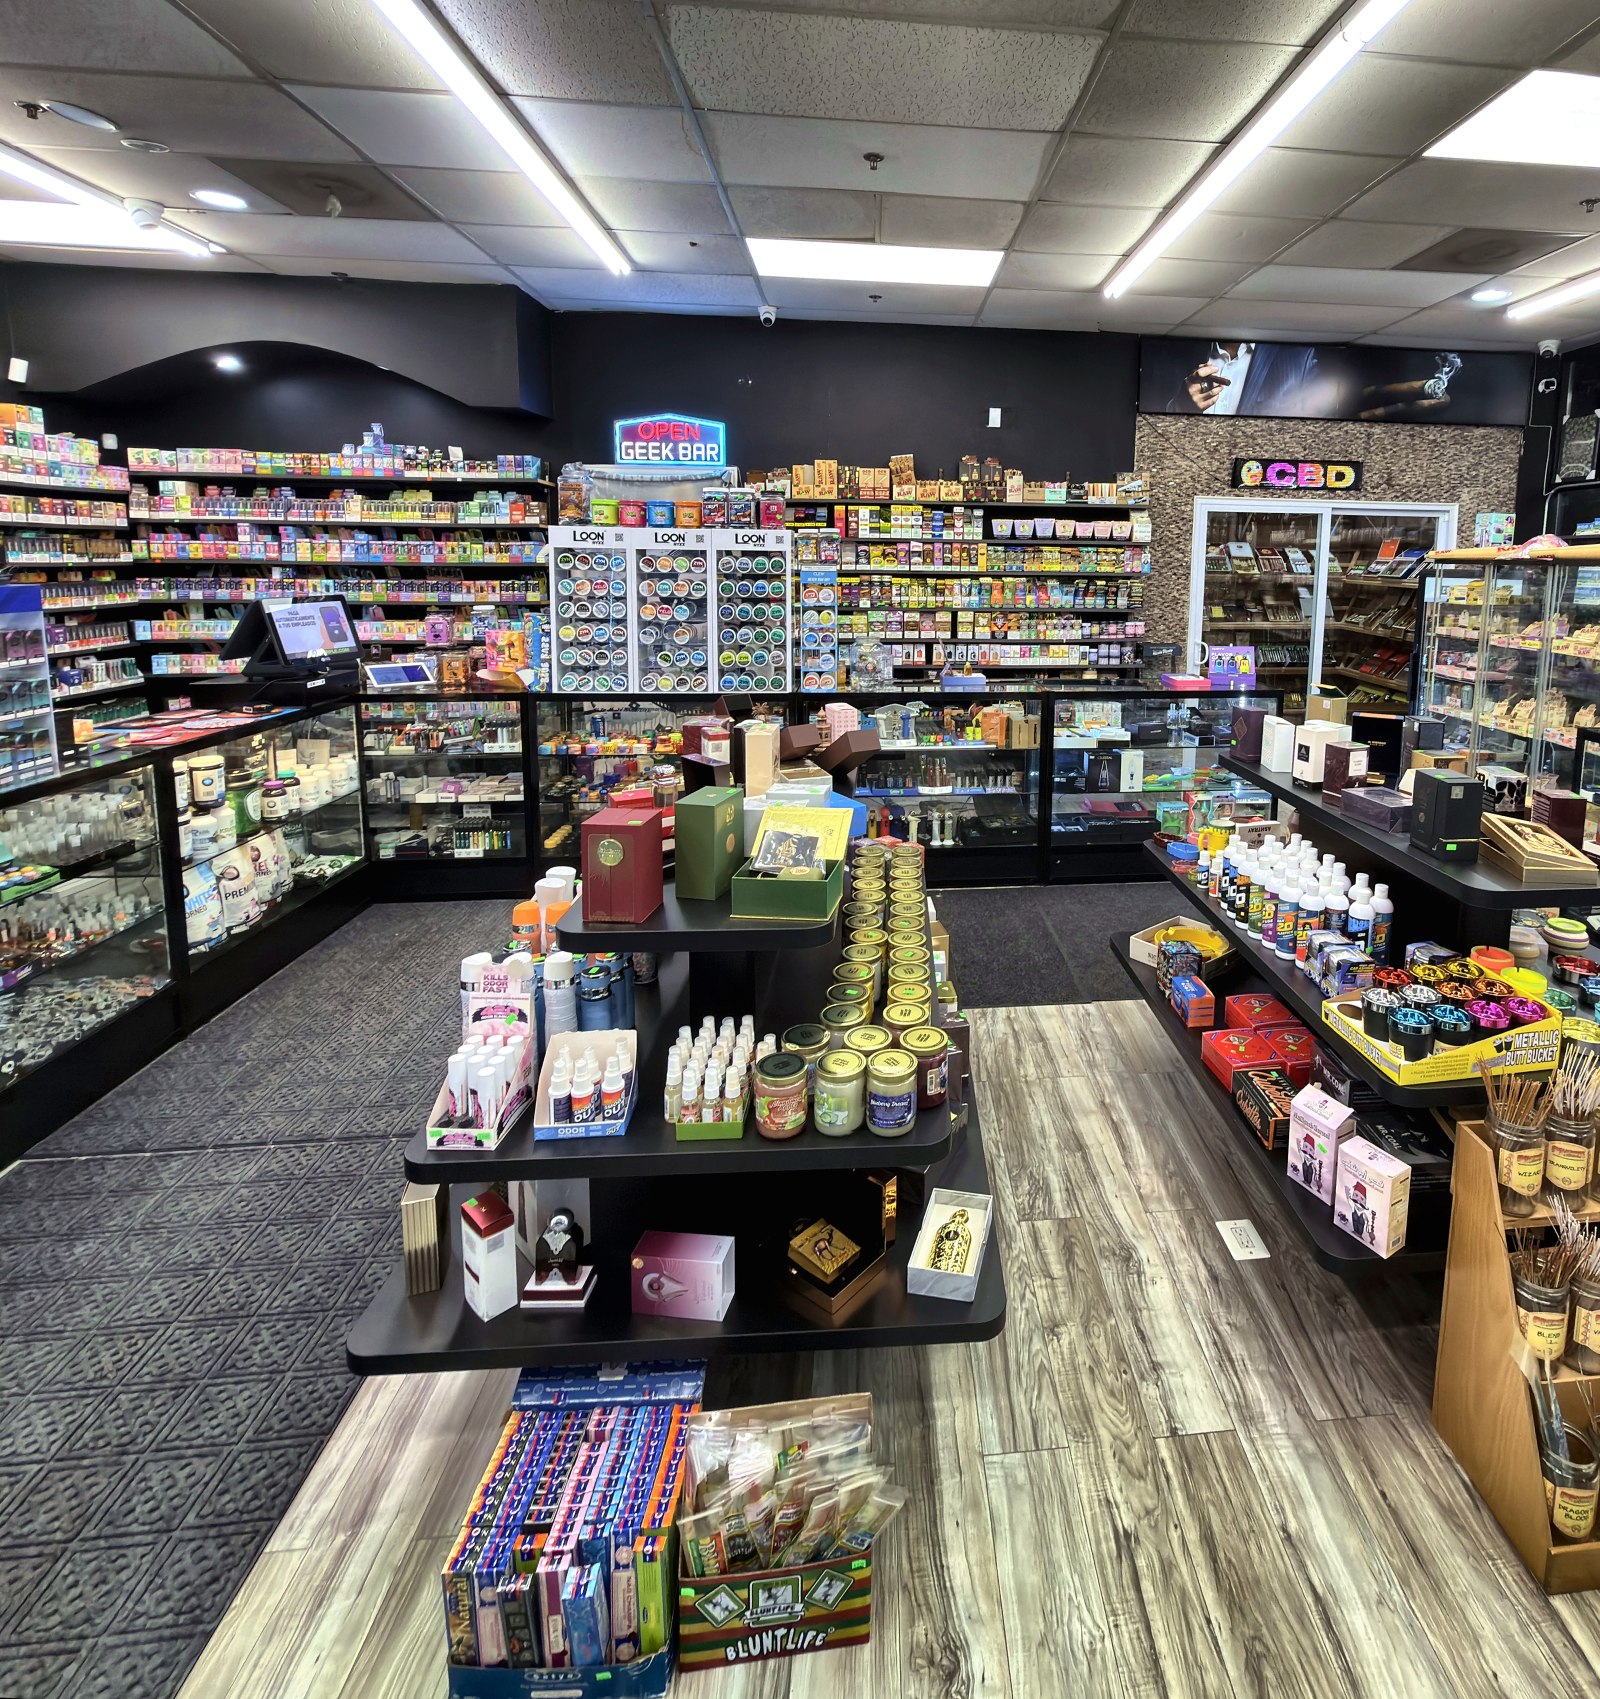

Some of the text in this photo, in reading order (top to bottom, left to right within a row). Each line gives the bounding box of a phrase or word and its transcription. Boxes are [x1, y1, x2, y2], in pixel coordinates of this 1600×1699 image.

[638, 421, 700, 441] OPEN
[621, 441, 719, 461] GEEK BAR
[1266, 462, 1355, 488] CBD
[897, 489, 912, 497] RAW
[920, 490, 936, 498] RAW
[944, 490, 960, 498] RAW
[573, 531, 604, 542] LOON
[655, 532, 686, 543] LOON
[735, 533, 766, 544] LOON
[1328, 1008, 1382, 1064] METALLIC BUTT BUCKET
[1514, 1029, 1559, 1050] METALLIC
[1505, 1047, 1558, 1066] BUTT BUCKET
[574, 1105, 595, 1122] OUT
[604, 1101, 626, 1118] OUT
[1375, 1124, 1402, 1150] MR.COAL
[457, 1576, 470, 1634] Natural
